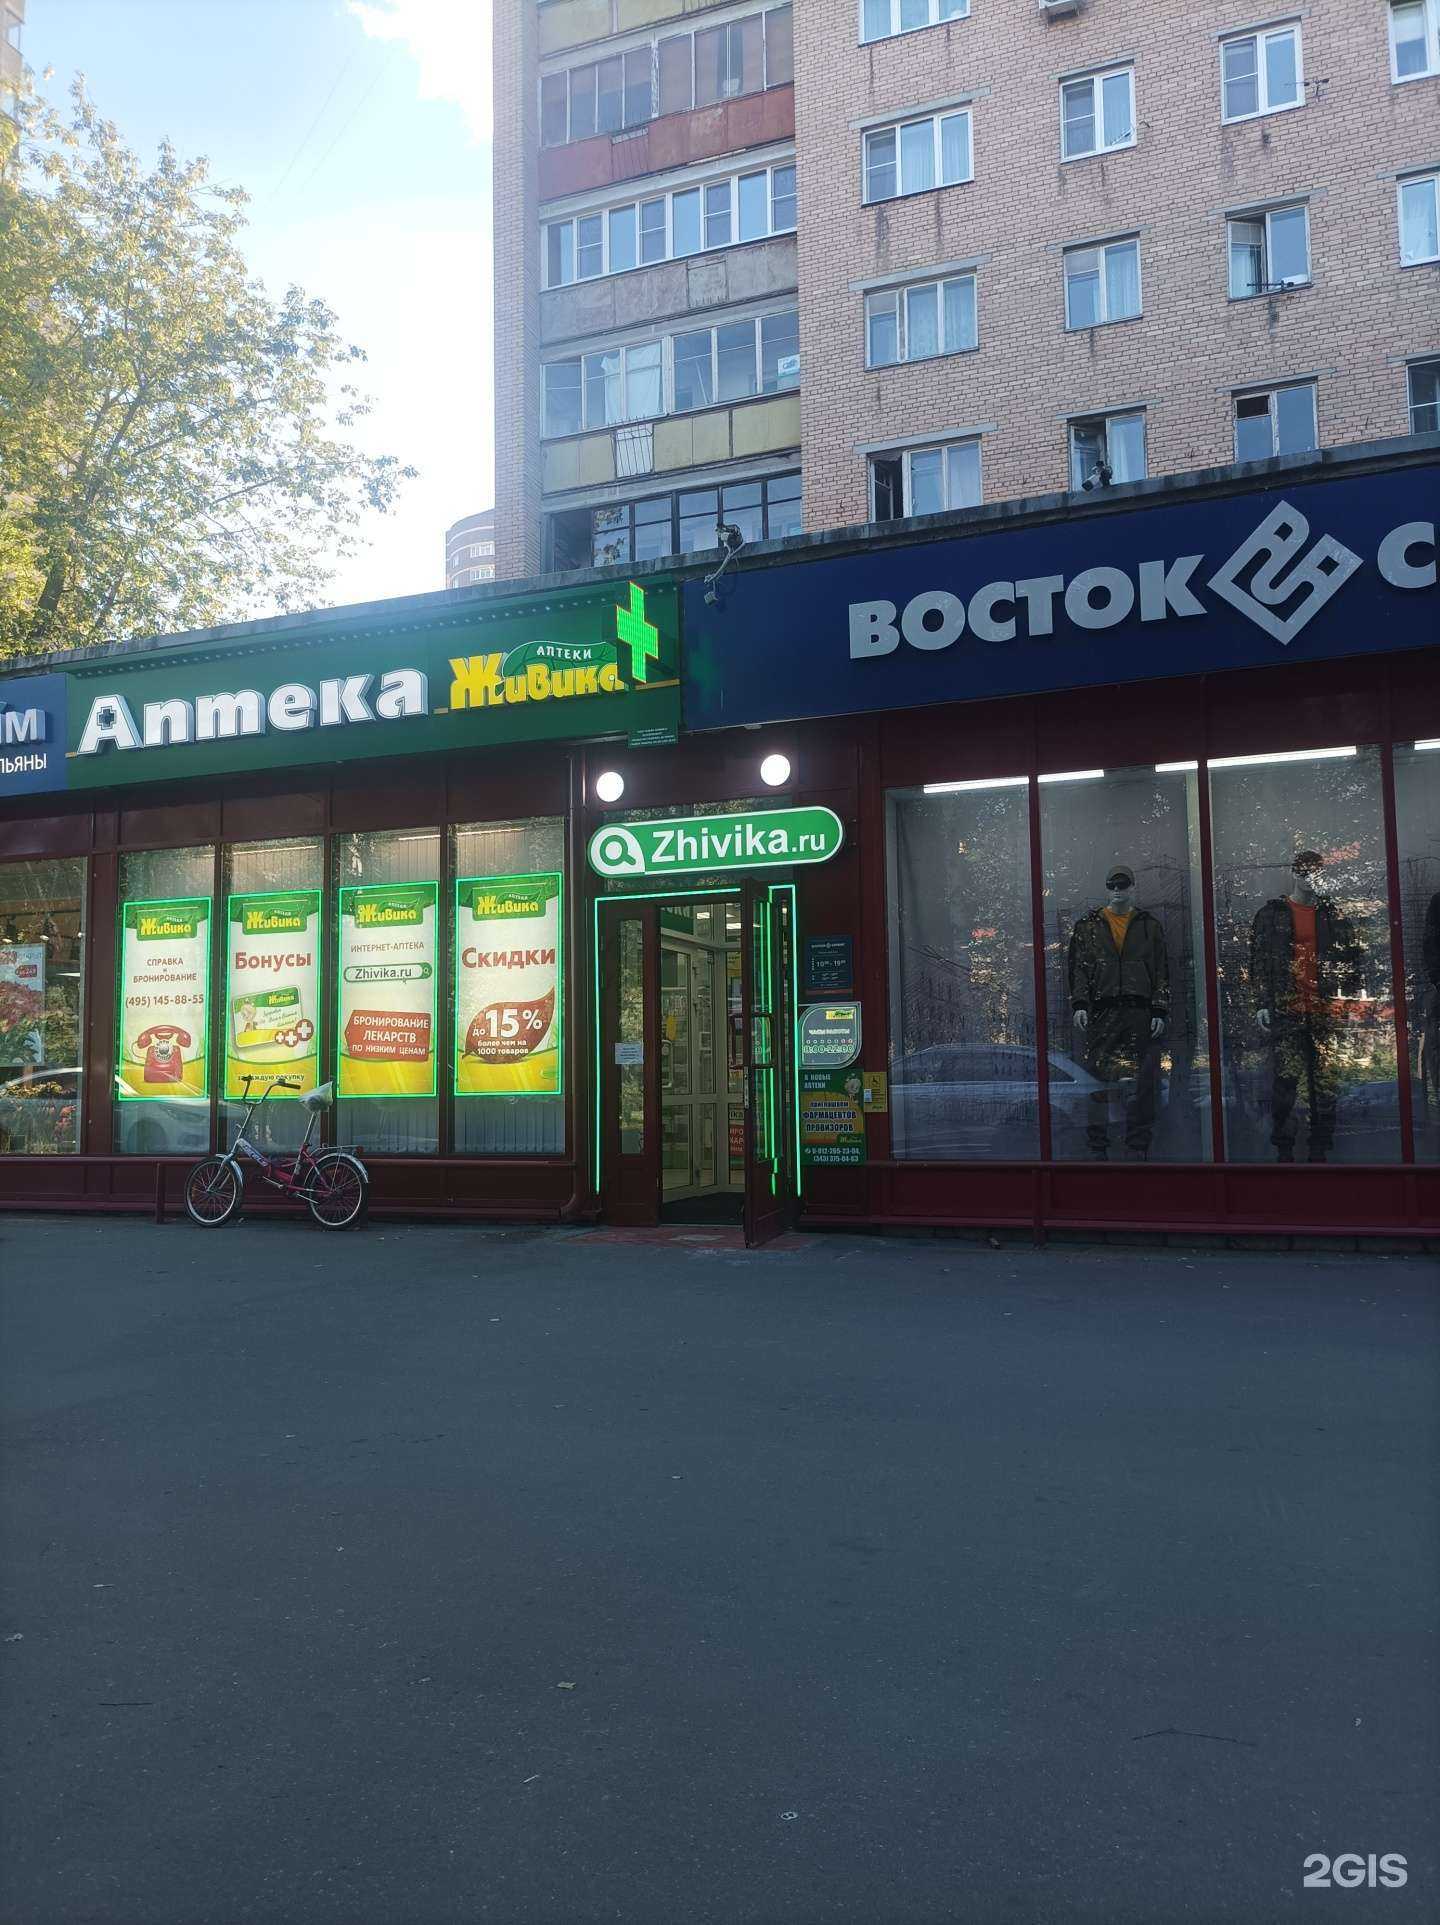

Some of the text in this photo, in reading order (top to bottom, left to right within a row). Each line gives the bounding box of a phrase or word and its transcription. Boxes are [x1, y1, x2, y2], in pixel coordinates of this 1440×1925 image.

[849, 553, 1208, 659] ВОСТОК
[536, 645, 592, 660] АПТЕКИ
[77, 667, 429, 755] Аптека
[652, 824, 826, 863] Zhivika.ru
[351, 941, 425, 953] ИНТЕРНЕТ-АПТЕКА
[147, 957, 184, 967] СПРАВКА
[235, 951, 312, 972] Бонусы
[462, 947, 556, 969] Скидки
[133, 973, 197, 984] БРОНИРОВАНИЕ
[355, 967, 412, 979] Zhivika.ru
[125, 994, 204, 1008] (495) 145-88-55
[353, 1015, 429, 1029] БРОНИРОВАНИЕ
[363, 1030, 417, 1043] ЛЕКАРСТВ
[472, 1028, 486, 1037] до
[352, 1044, 426, 1056] ПО НИЗКИМ ЦЕНАМ
[478, 1047, 497, 1055] 1000
